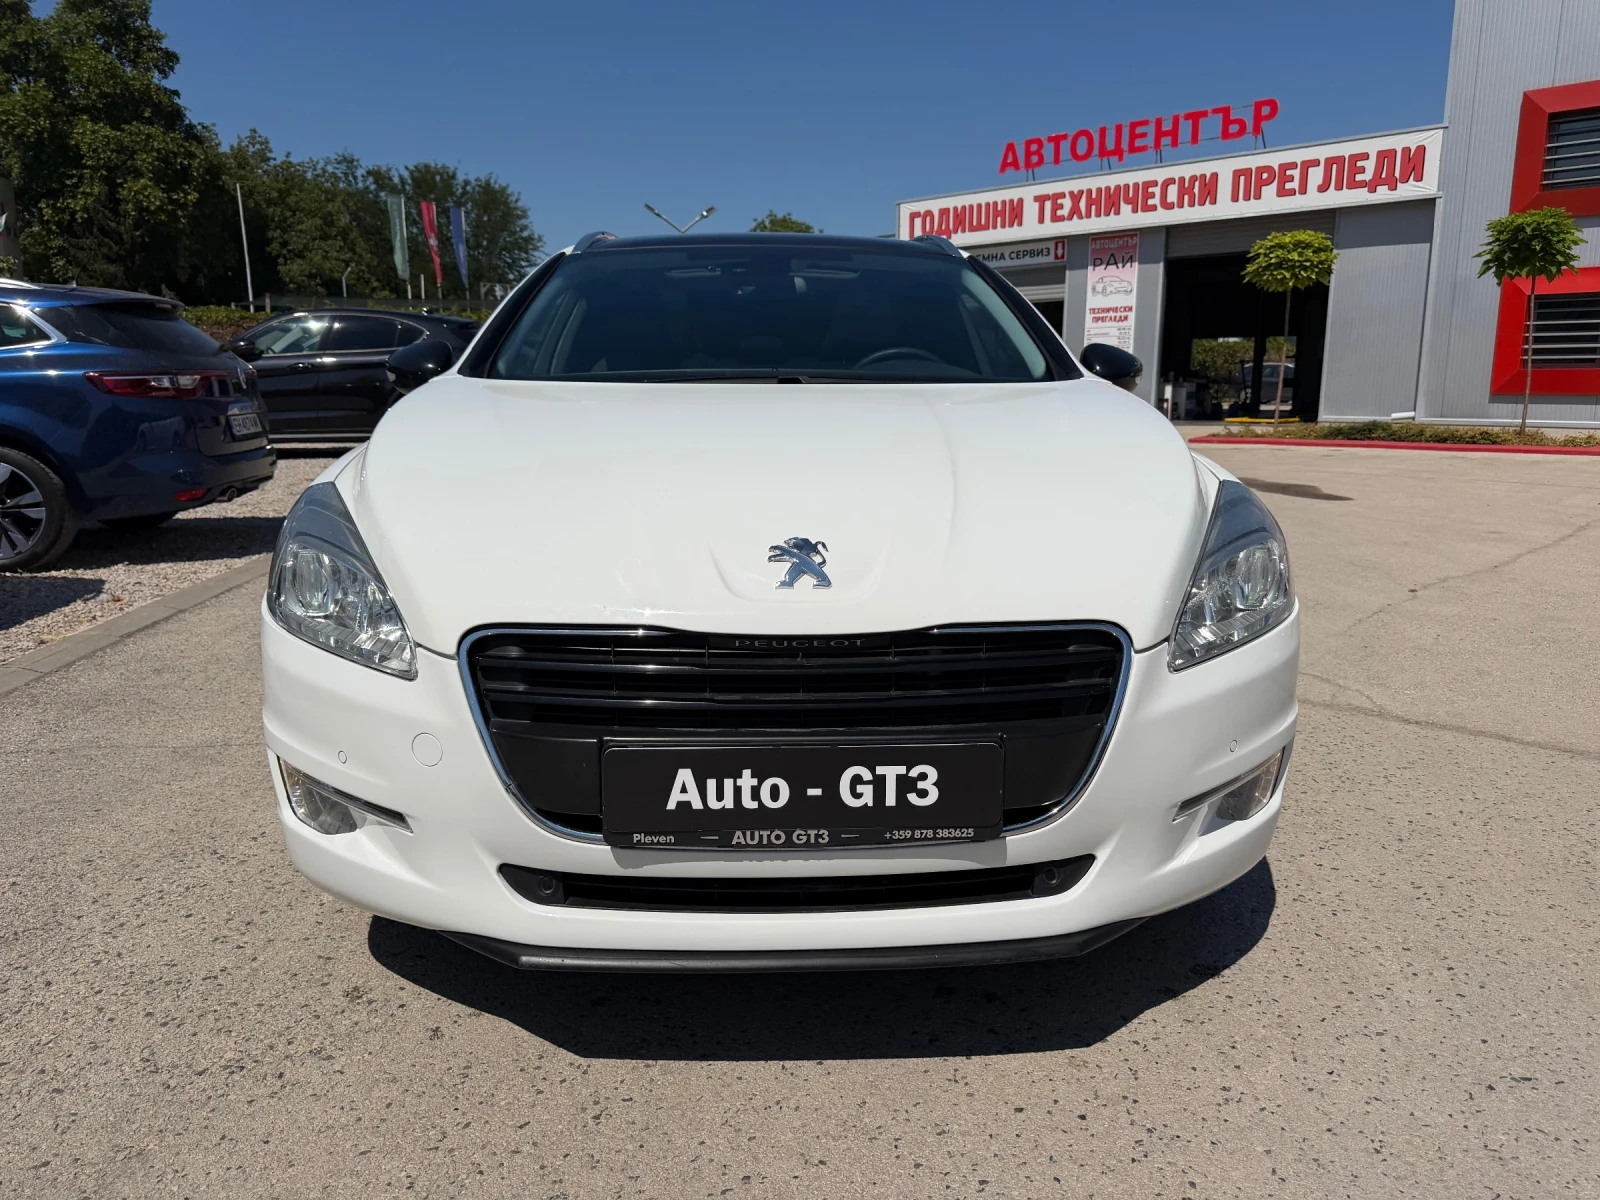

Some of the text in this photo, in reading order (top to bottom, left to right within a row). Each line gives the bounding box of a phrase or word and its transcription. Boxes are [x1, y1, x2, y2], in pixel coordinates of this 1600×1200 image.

[999, 98, 1280, 174] АВТОЦЕНТЪР
[909, 144, 1426, 240] ГОДИШНИ ТЕХНИЧЕСКИ ПРЕГЛЕДИ
[1091, 237, 1137, 249] АВТОЦЕНТЪР
[1008, 247, 1051, 260] СЕРВИЗ
[1088, 306, 1133, 315] ТЕХНИЧЕСКИ
[1092, 315, 1128, 323] ПРЕГЛЕДИ
[735, 639, 866, 648] PEUGEOT
[666, 768, 790, 810] Auto
[839, 764, 939, 807] GT3
[633, 828, 974, 845] Pleven AUTO GT3 +359 878 383625
